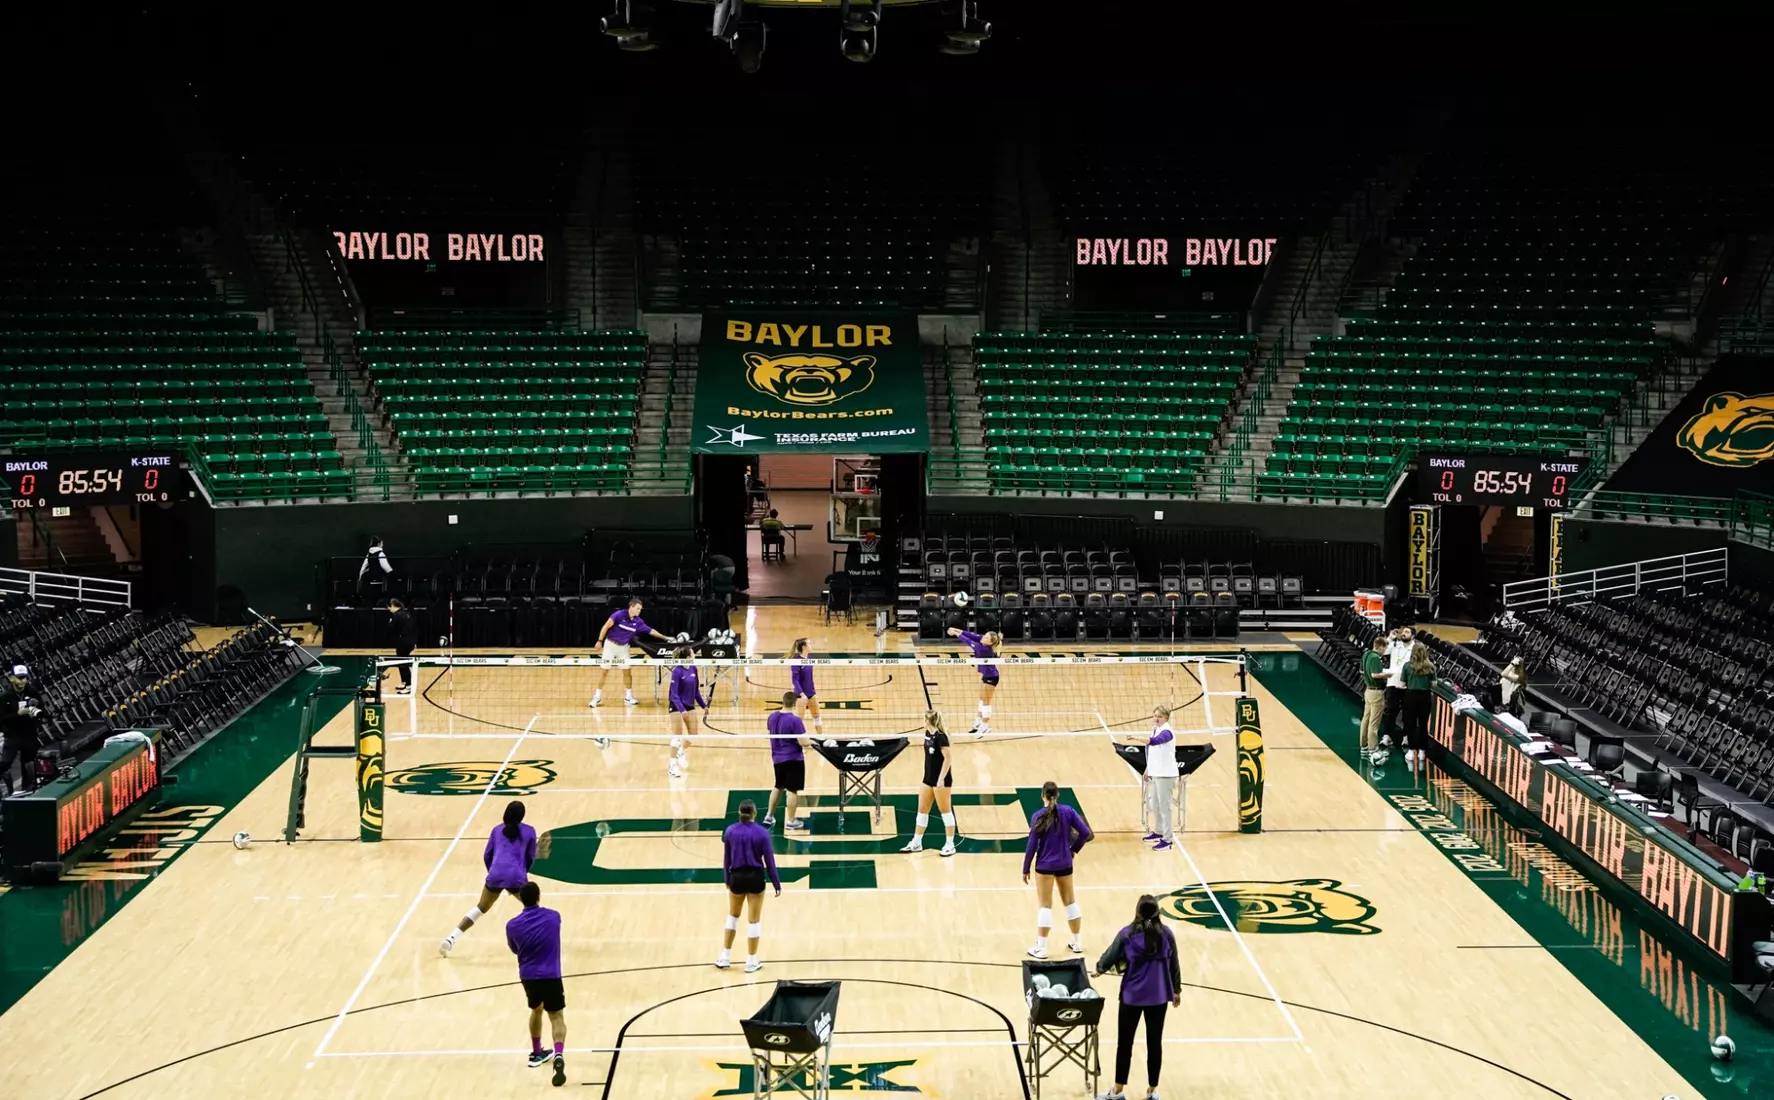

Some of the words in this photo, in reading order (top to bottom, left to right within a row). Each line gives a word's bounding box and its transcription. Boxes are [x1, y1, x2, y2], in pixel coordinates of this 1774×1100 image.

[448, 233, 544, 261] BAYLOR
[1076, 238, 1169, 265] BAYLOR
[726, 320, 892, 348] BAYLOR
[727, 406, 893, 419] BaylorBears.com
[861, 428, 916, 437] BUREAU
[5, 461, 48, 472] BAYLOR
[131, 456, 171, 467] K-STATE
[1429, 458, 1466, 468] BAYLOR
[1540, 462, 1579, 473] K-STATE
[20, 474, 36, 495] 0
[58, 469, 123, 494] 85:54
[144, 469, 159, 489] 0
[1440, 471, 1454, 490] 0
[1473, 470, 1533, 494] 85:54
[1552, 475, 1566, 496] 0
[11, 499, 33, 508] TOL
[38, 498, 46, 507] 0
[136, 493, 157, 502] TOL
[161, 492, 168, 501] 0
[1432, 492, 1452, 502] TOL
[1456, 494, 1462, 503] 0
[1543, 498, 1563, 508] TOL
[1412, 513, 1425, 593] BAYLOR
[843, 753, 879, 763] Baden
[58, 781, 104, 855] AYLOR
[111, 745, 157, 817] BAYLOR
[1464, 716, 1532, 808] BAYLOR
[1542, 769, 1626, 880] BAYLOR
[1452, 854, 1508, 872] 2021
